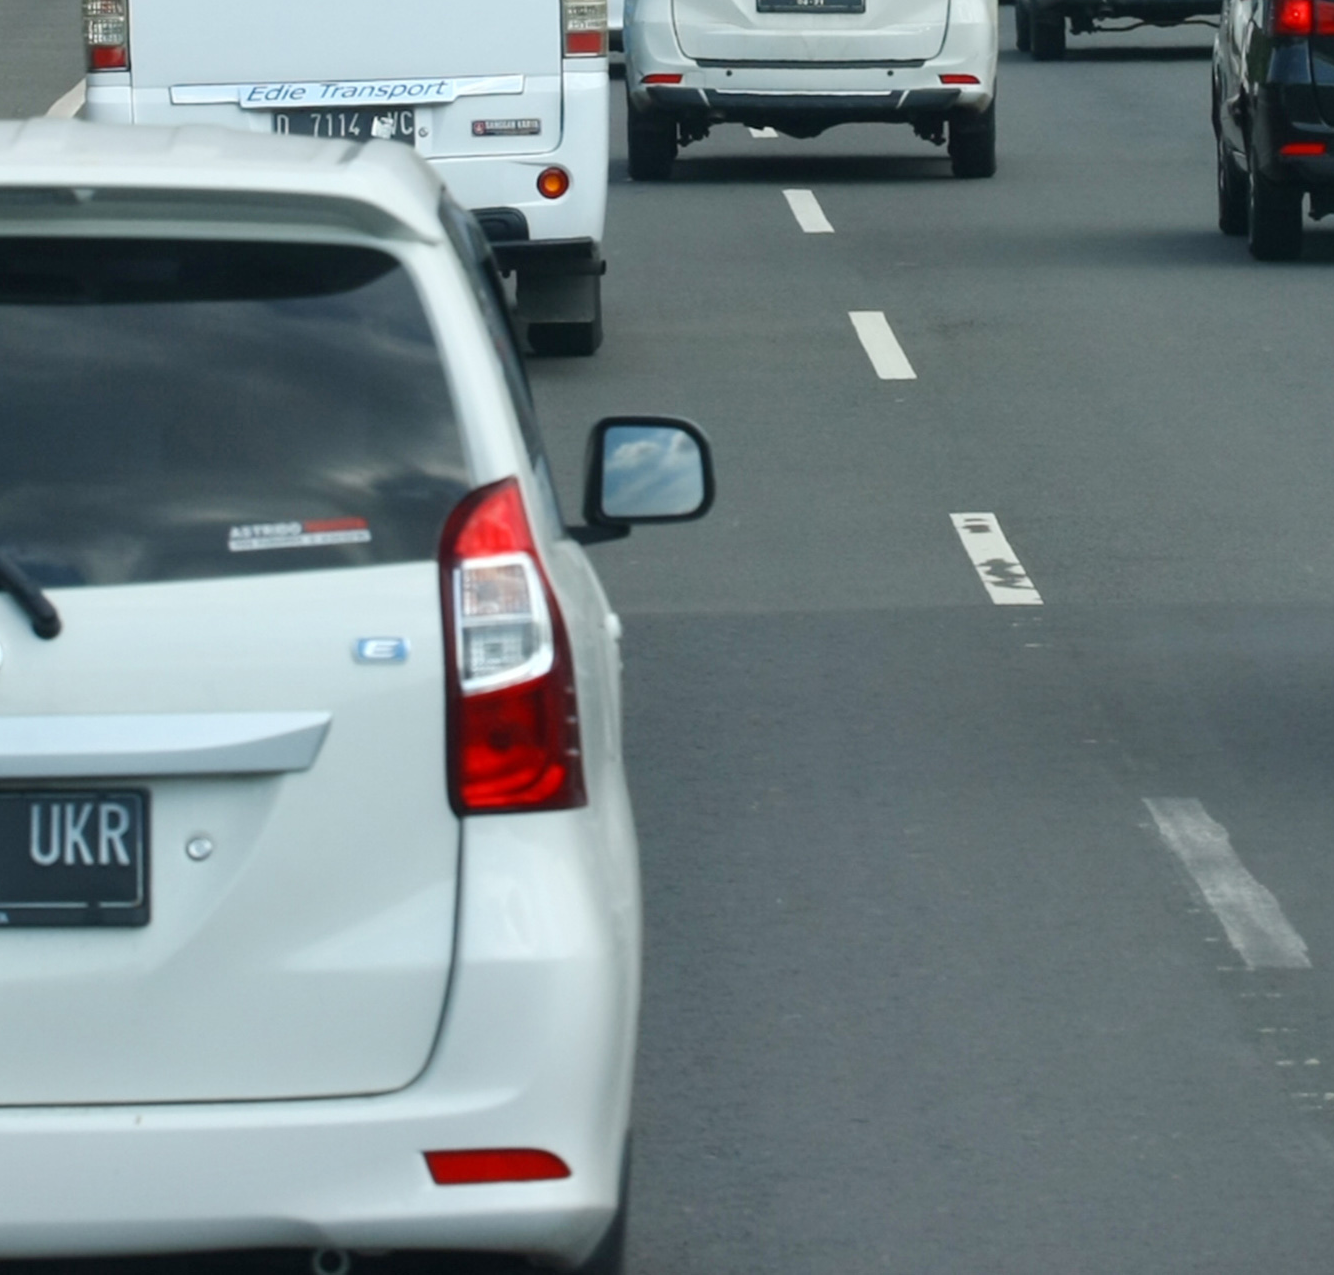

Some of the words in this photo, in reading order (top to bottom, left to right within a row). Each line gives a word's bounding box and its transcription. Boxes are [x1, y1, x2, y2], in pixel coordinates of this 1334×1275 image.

[246, 84, 307, 102] Edie
[318, 80, 449, 101] Transport
[310, 112, 361, 137] 7114
[29, 803, 131, 866] UKR
